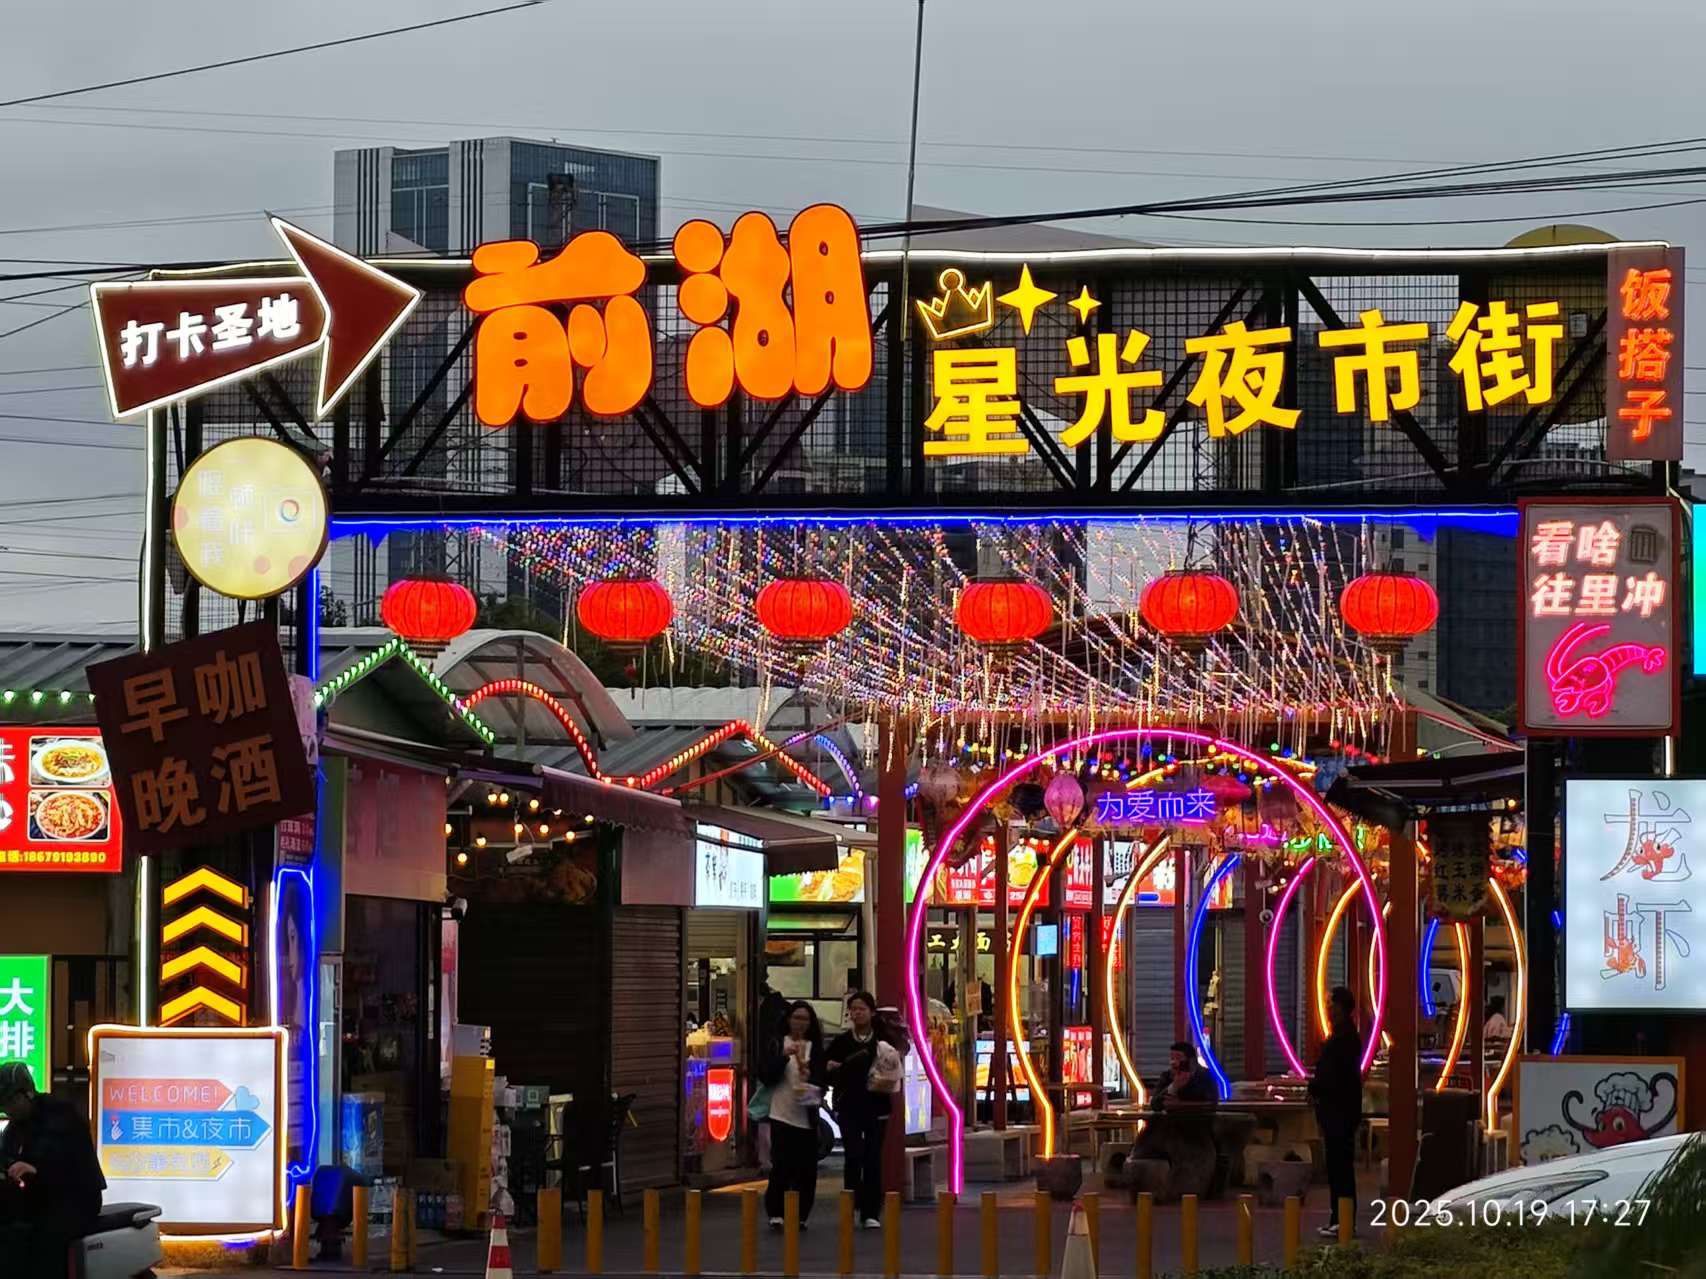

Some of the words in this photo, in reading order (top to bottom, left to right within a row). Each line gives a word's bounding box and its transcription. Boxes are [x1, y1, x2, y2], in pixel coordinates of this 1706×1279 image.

[121, 293, 300, 368] 打卡圣地
[465, 203, 873, 426] 前湖
[1619, 268, 1673, 443] 饭搭子
[923, 301, 1564, 457] 星光夜市街
[1531, 519, 1620, 567] 看啥
[1531, 571, 1667, 618] 往里冲
[120, 650, 267, 742] 早咖
[131, 734, 282, 833] 晚酒
[1097, 790, 1217, 824] 为爱而来
[1600, 789, 1692, 990] 龙虾
[110, 1085, 218, 1105] WELCOME!
[131, 1117, 251, 1141] 集市&夜市
